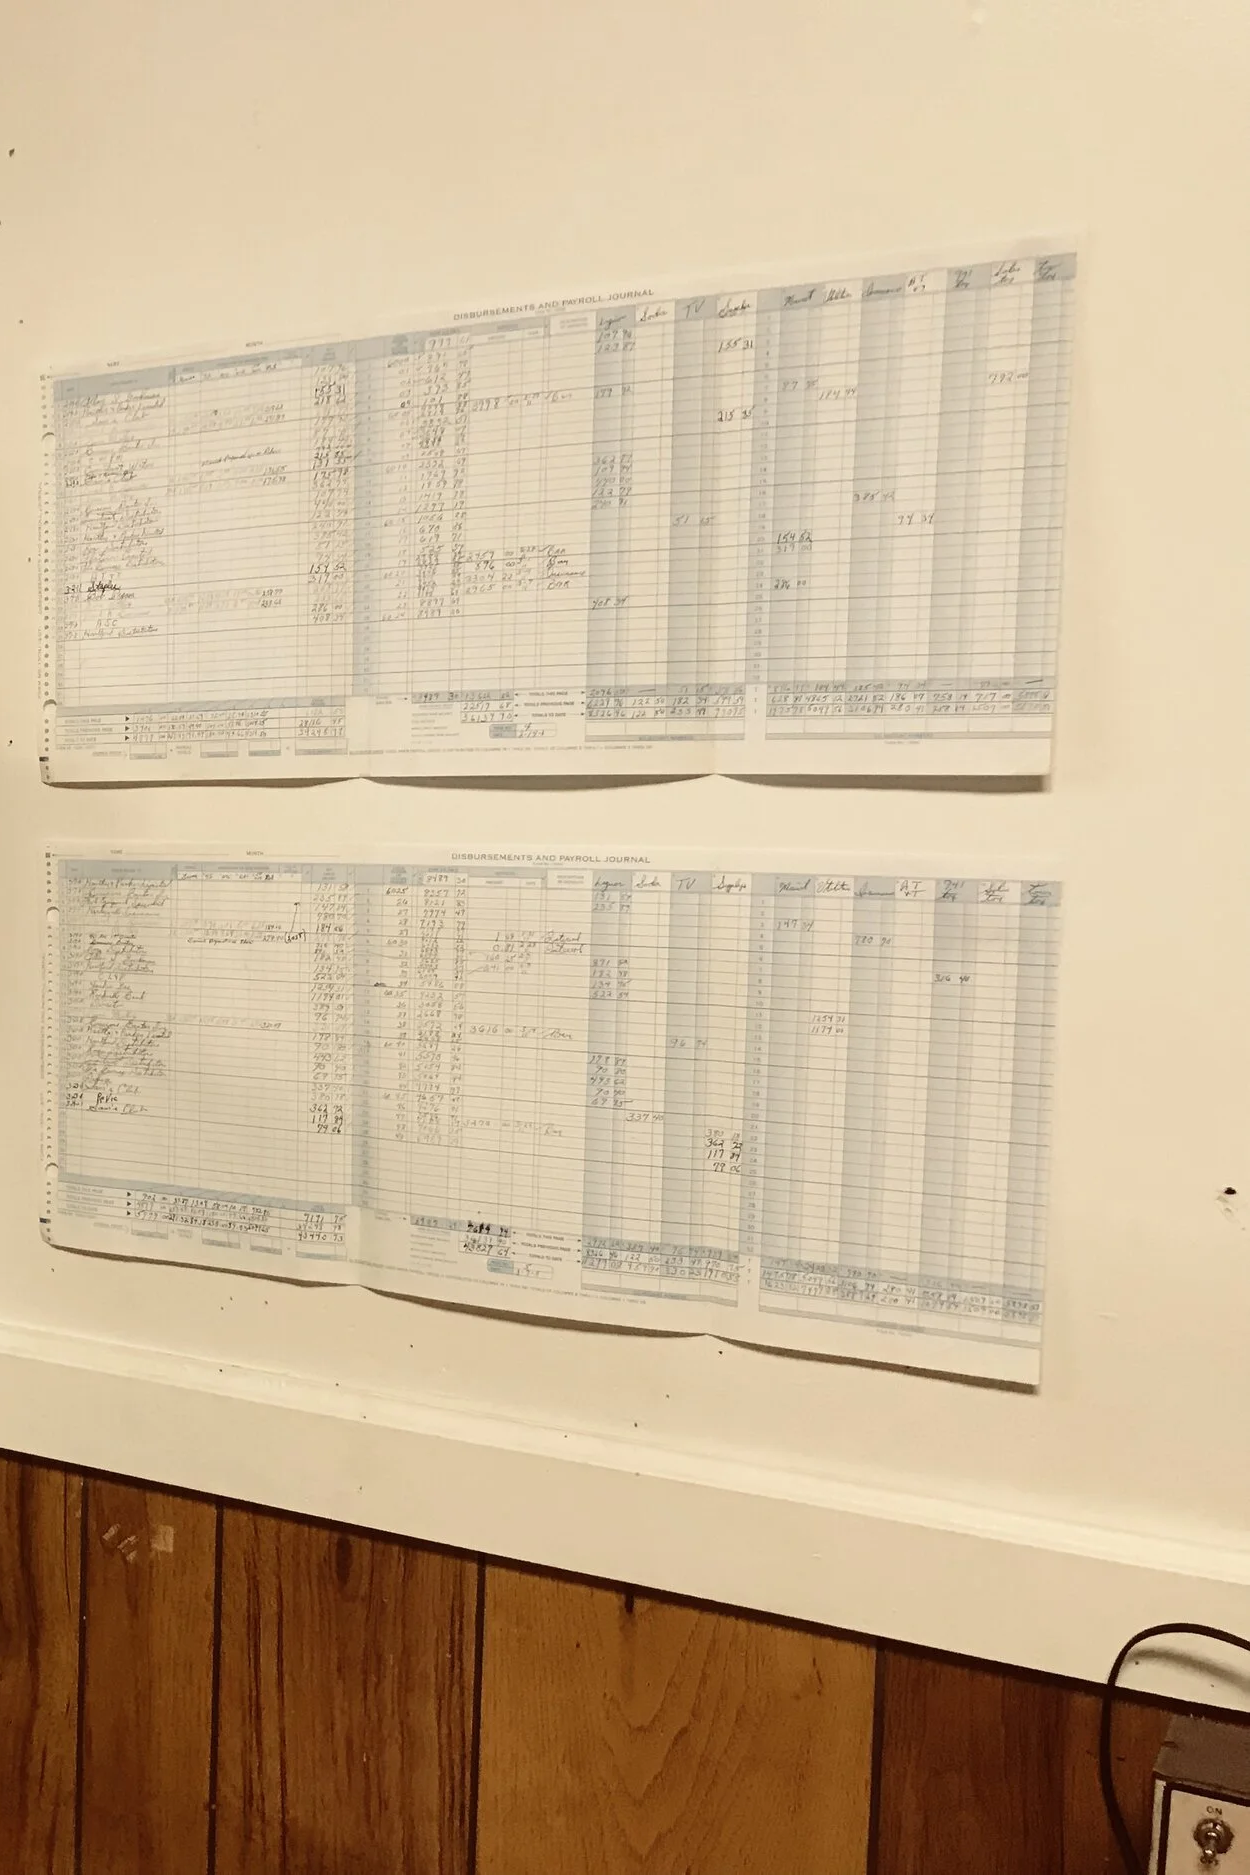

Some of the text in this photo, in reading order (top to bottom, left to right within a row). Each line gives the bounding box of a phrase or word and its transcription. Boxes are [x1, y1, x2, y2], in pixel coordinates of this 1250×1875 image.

[453, 288, 655, 321] DISBURSEMENTS AND PAYROLL JOURNAL
[685, 300, 705, 319] TV
[451, 852, 651, 864] DISBURSEMENTS AND PAYROLL JOURNAL
[676, 878, 696, 890] TV
[310, 1104, 328, 1113] 362
[312, 1114, 328, 1124] 117
[705, 1139, 724, 1147] 362
[707, 1149, 724, 1159] 117
[1206, 1805, 1223, 1816] ON
